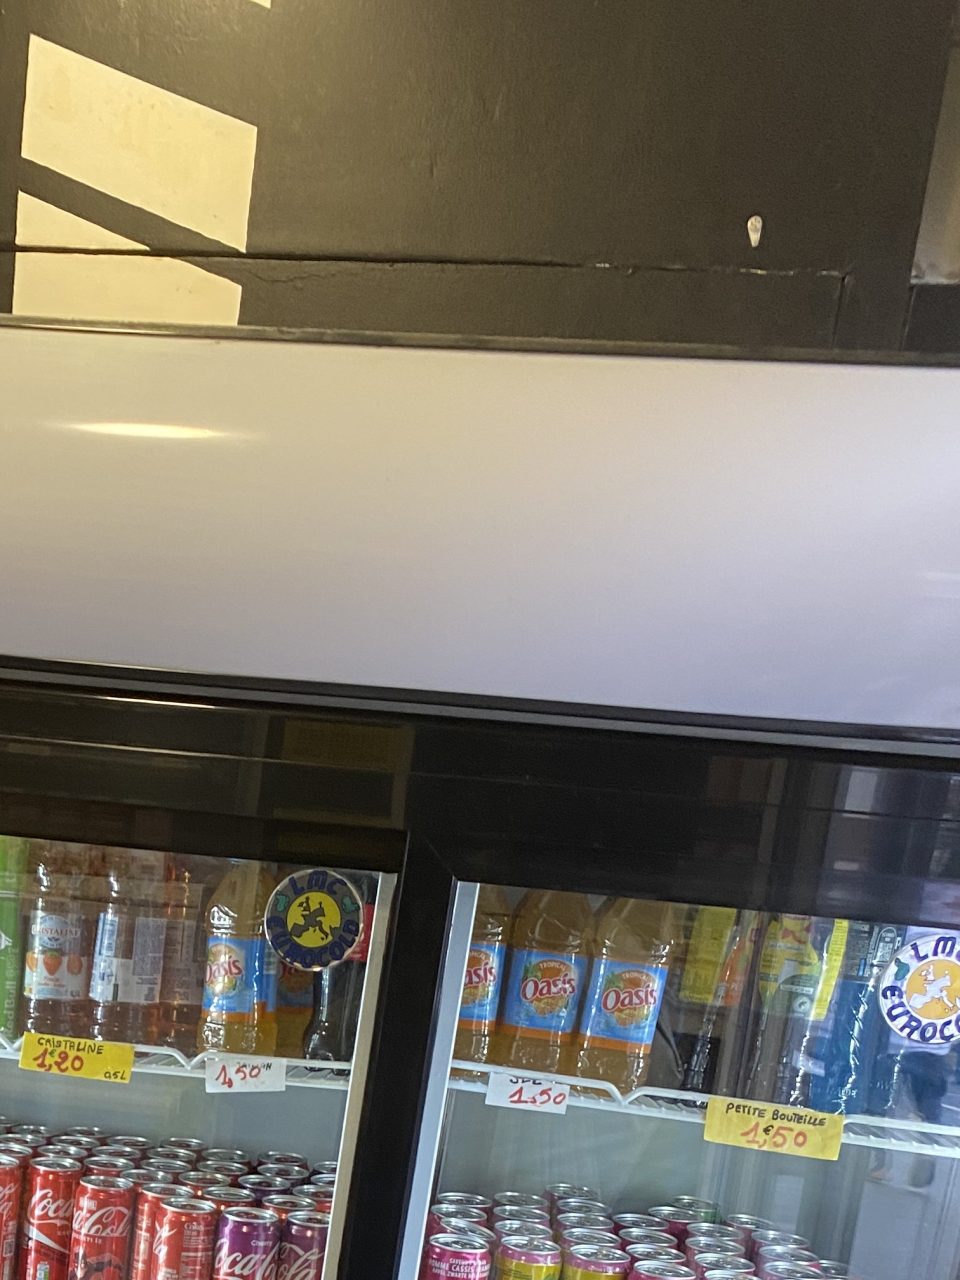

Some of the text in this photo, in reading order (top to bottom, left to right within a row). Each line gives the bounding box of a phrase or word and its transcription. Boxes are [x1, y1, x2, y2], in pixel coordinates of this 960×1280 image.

[910, 935, 960, 963] LM
[521, 972, 577, 1002] Oasis
[601, 982, 658, 1014] Oasis
[36, 1036, 105, 1055] CRISTALINE
[725, 1101, 828, 1128] PETITE BOUTEILLE
[451, 1263, 475, 1273] CASSIS
